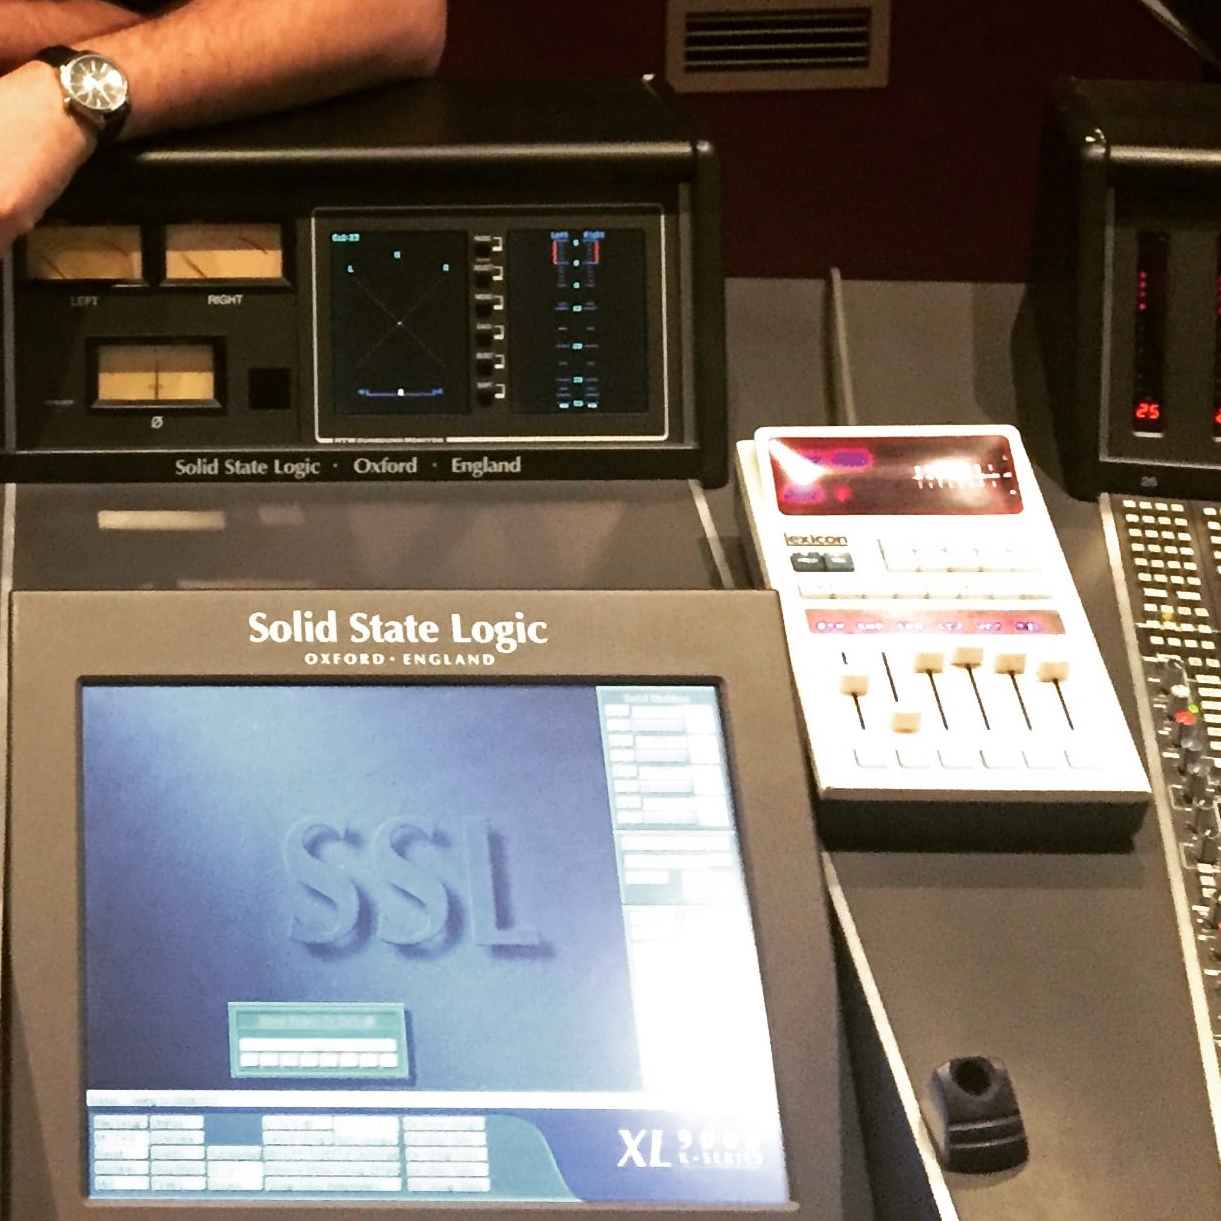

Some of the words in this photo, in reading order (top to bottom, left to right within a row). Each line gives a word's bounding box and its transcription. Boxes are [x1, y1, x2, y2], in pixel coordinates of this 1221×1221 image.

[208, 294, 243, 305] RIGHT
[1136, 403, 1160, 419] 25
[176, 457, 219, 475] Solid
[224, 458, 269, 475] State
[274, 457, 320, 479] Logic
[354, 457, 418, 475] Oxford
[451, 455, 522, 478] England
[784, 532, 848, 546] lexicon
[248, 609, 338, 643] Solid
[349, 612, 440, 643] State
[451, 611, 549, 654] Logic
[304, 652, 385, 666] OXFORD
[402, 652, 496, 666] ENGLAND
[284, 814, 550, 958] SSL
[617, 1129, 671, 1168] XL
